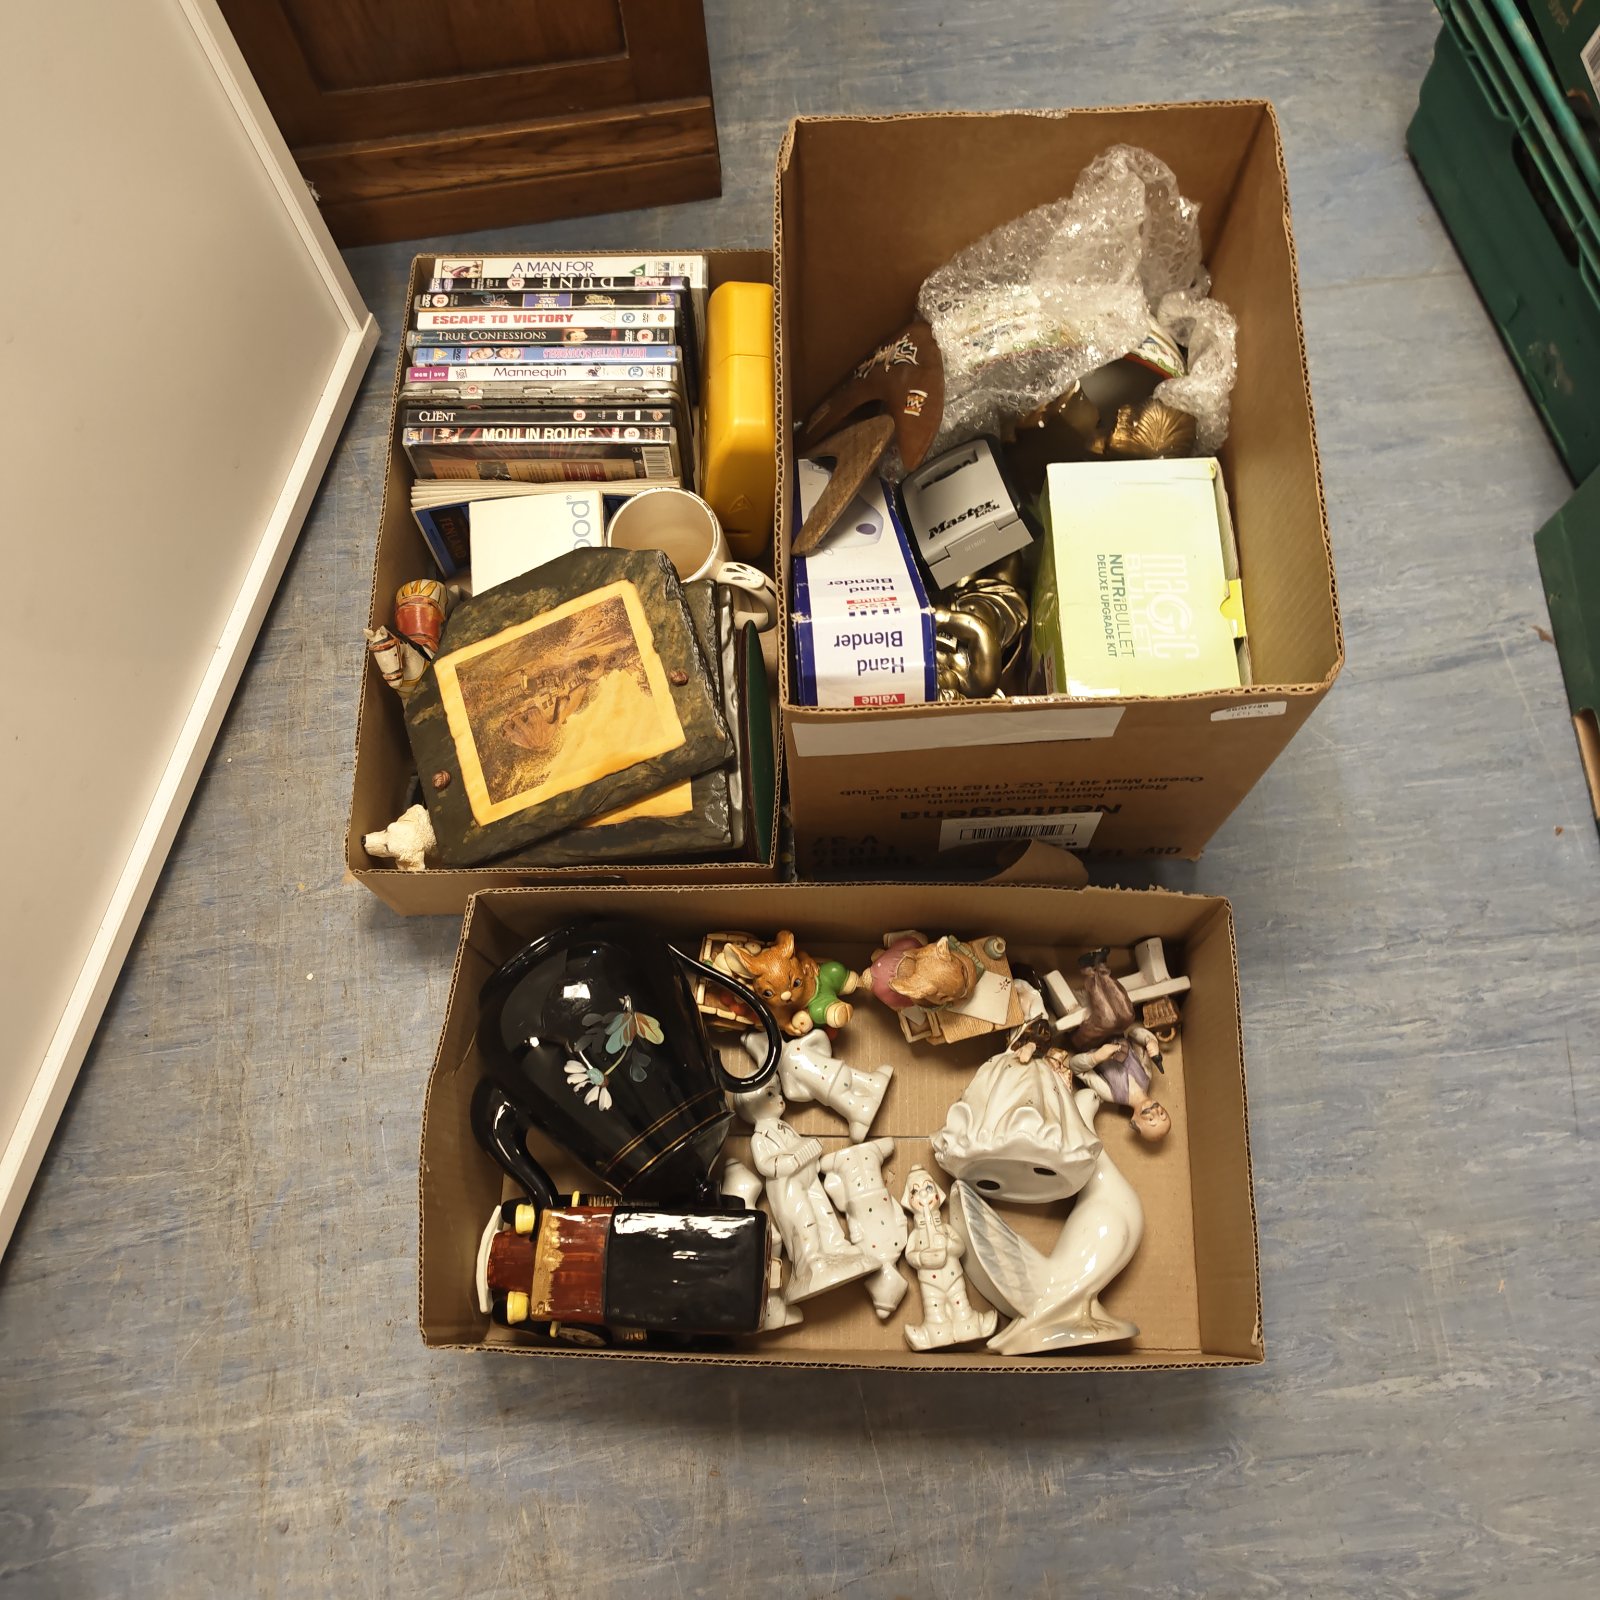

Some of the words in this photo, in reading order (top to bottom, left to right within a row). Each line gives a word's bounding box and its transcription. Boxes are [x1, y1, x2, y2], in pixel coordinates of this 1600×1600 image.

[512, 262, 523, 272] A
[527, 261, 562, 272] MAN
[566, 261, 594, 272] FOR
[542, 277, 614, 289] DUNE
[432, 314, 487, 325] ESCAPE
[490, 314, 509, 324] TO
[514, 313, 573, 324] VICTORY
[436, 331, 467, 341] TRUE
[469, 330, 547, 340] CONFESSIONS
[493, 367, 567, 378] Mannequin
[418, 410, 456, 422] CLIENT
[482, 428, 540, 441] MOULIN
[543, 427, 594, 440] ROUGE
[928, 499, 994, 540] Master
[1096, 554, 1109, 591] DELUXE
[827, 577, 893, 586] Blender
[849, 585, 894, 593] Hand
[1100, 594, 1114, 640] UPGRADE
[834, 630, 903, 650] Blender
[1107, 643, 1117, 658] KIT
[857, 656, 904, 676] Hand
[861, 694, 898, 705] value
[987, 788, 1049, 796] Shower
[1054, 784, 1168, 793] Replenishing
[1005, 793, 1104, 801] Neutrogena
[900, 804, 1123, 820] Neutrogena
